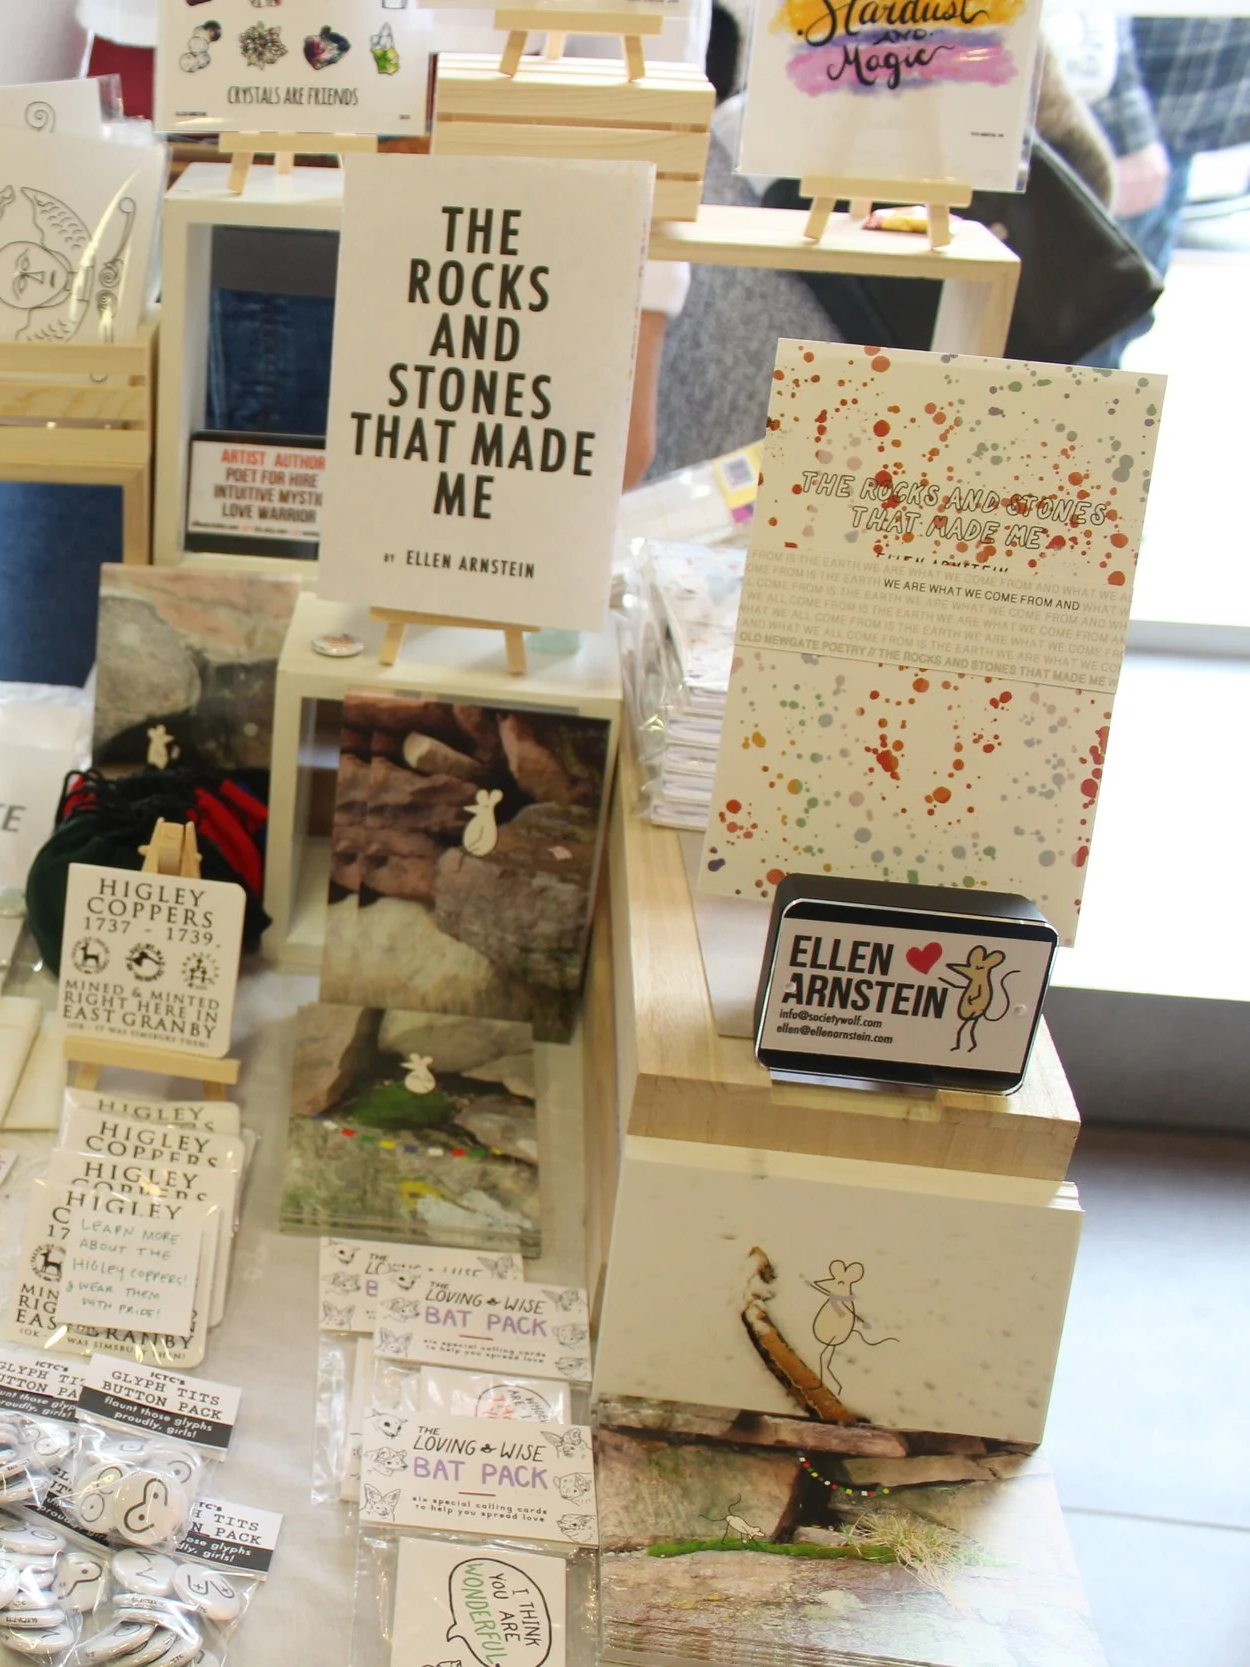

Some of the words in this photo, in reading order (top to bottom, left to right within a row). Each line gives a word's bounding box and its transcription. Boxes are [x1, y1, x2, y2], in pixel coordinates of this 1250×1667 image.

[873, 28, 926, 45] AND
[827, 46, 955, 89] Magic
[227, 85, 281, 105] CRYSTALS
[283, 86, 305, 105] ARE
[307, 87, 359, 106] FRIENDS
[441, 205, 522, 256] THE
[407, 258, 550, 313] ROCKS
[429, 312, 521, 362] AND
[387, 362, 552, 420] STONES
[221, 448, 266, 466] ARTIST
[274, 452, 326, 471] AUTHOR
[350, 411, 457, 464] THAT
[470, 421, 596, 477] MADE
[213, 483, 274, 503] INTUITIVE
[226, 467, 257, 483] POET
[260, 470, 286, 486] FOR
[288, 473, 319, 489] HIRE
[433, 470, 495, 520] ME
[802, 470, 855, 498] THE
[859, 476, 940, 507] ROCKS
[944, 486, 1000, 515] AND
[1005, 493, 1107, 526] STONES
[221, 502, 253, 519] LOVE
[258, 506, 317, 524] WARRIOR
[852, 505, 921, 535] THAT
[925, 514, 1000, 545] MADE
[1004, 524, 1046, 550] ME
[383, 552, 395, 564] BY
[406, 549, 452, 570] ELLEN
[458, 555, 535, 580] ARNSTEIN
[883, 578, 901, 590] WE
[903, 580, 926, 593] ARE
[928, 583, 962, 597] WHAT
[964, 588, 983, 600] WE
[984, 590, 1017, 604] COME
[1019, 594, 1053, 609] FROM
[1055, 599, 1080, 612] AND
[98, 877, 207, 908] HIGLEY
[83, 915, 132, 935] 1737
[86, 896, 214, 929] COPPERS
[789, 934, 895, 976] ELLEN
[64, 979, 124, 996] MINED
[150, 990, 220, 1011] MINTED
[64, 991, 129, 1010] RIGHT
[137, 1001, 187, 1019] HERE
[196, 1011, 218, 1025] IN
[781, 972, 949, 1020] ARNSTEIN
[62, 1004, 116, 1024] EAST
[122, 1012, 216, 1040] GRANBY
[776, 1023, 894, 1045] ellen@ellenarnstein.com
[779, 1008, 883, 1029] info@societywolf.com
[100, 1120, 212, 1154] HIGLEY
[81, 1218, 135, 1237] LEARN
[142, 1229, 181, 1246] MORE
[79, 1238, 128, 1255] ABOUT
[136, 1247, 172, 1262] THE
[125, 1287, 161, 1301] THEM
[101, 1380, 168, 1408] BUTTON
[177, 1402, 223, 1421] PACK
[111, 1370, 166, 1393] GLYPH
[176, 1387, 221, 1406] TITS
[103, 1395, 138, 1410] flaunt
[139, 1406, 172, 1422] those
[173, 1416, 213, 1434] glyphs
[112, 1410, 162, 1430] proudly,
[165, 1423, 199, 1440] girls!
[418, 1425, 442, 1436] THE
[412, 1435, 477, 1456] LOVING
[500, 1441, 547, 1463] WISE
[412, 1456, 466, 1482] BAT
[481, 1462, 549, 1491] PACK
[430, 1504, 454, 1515] help
[457, 1508, 477, 1517] you
[480, 1510, 518, 1521] spread
[522, 1513, 546, 1523] love
[432, 1498, 471, 1509] special
[475, 1501, 513, 1514] calling
[517, 1505, 548, 1516] cards
[488, 1572, 510, 1600] YOU
[512, 1587, 530, 1596] I
[461, 1562, 508, 1665] WONDERFUL
[498, 1610, 521, 1643] ARE
[518, 1601, 543, 1647] THINK
